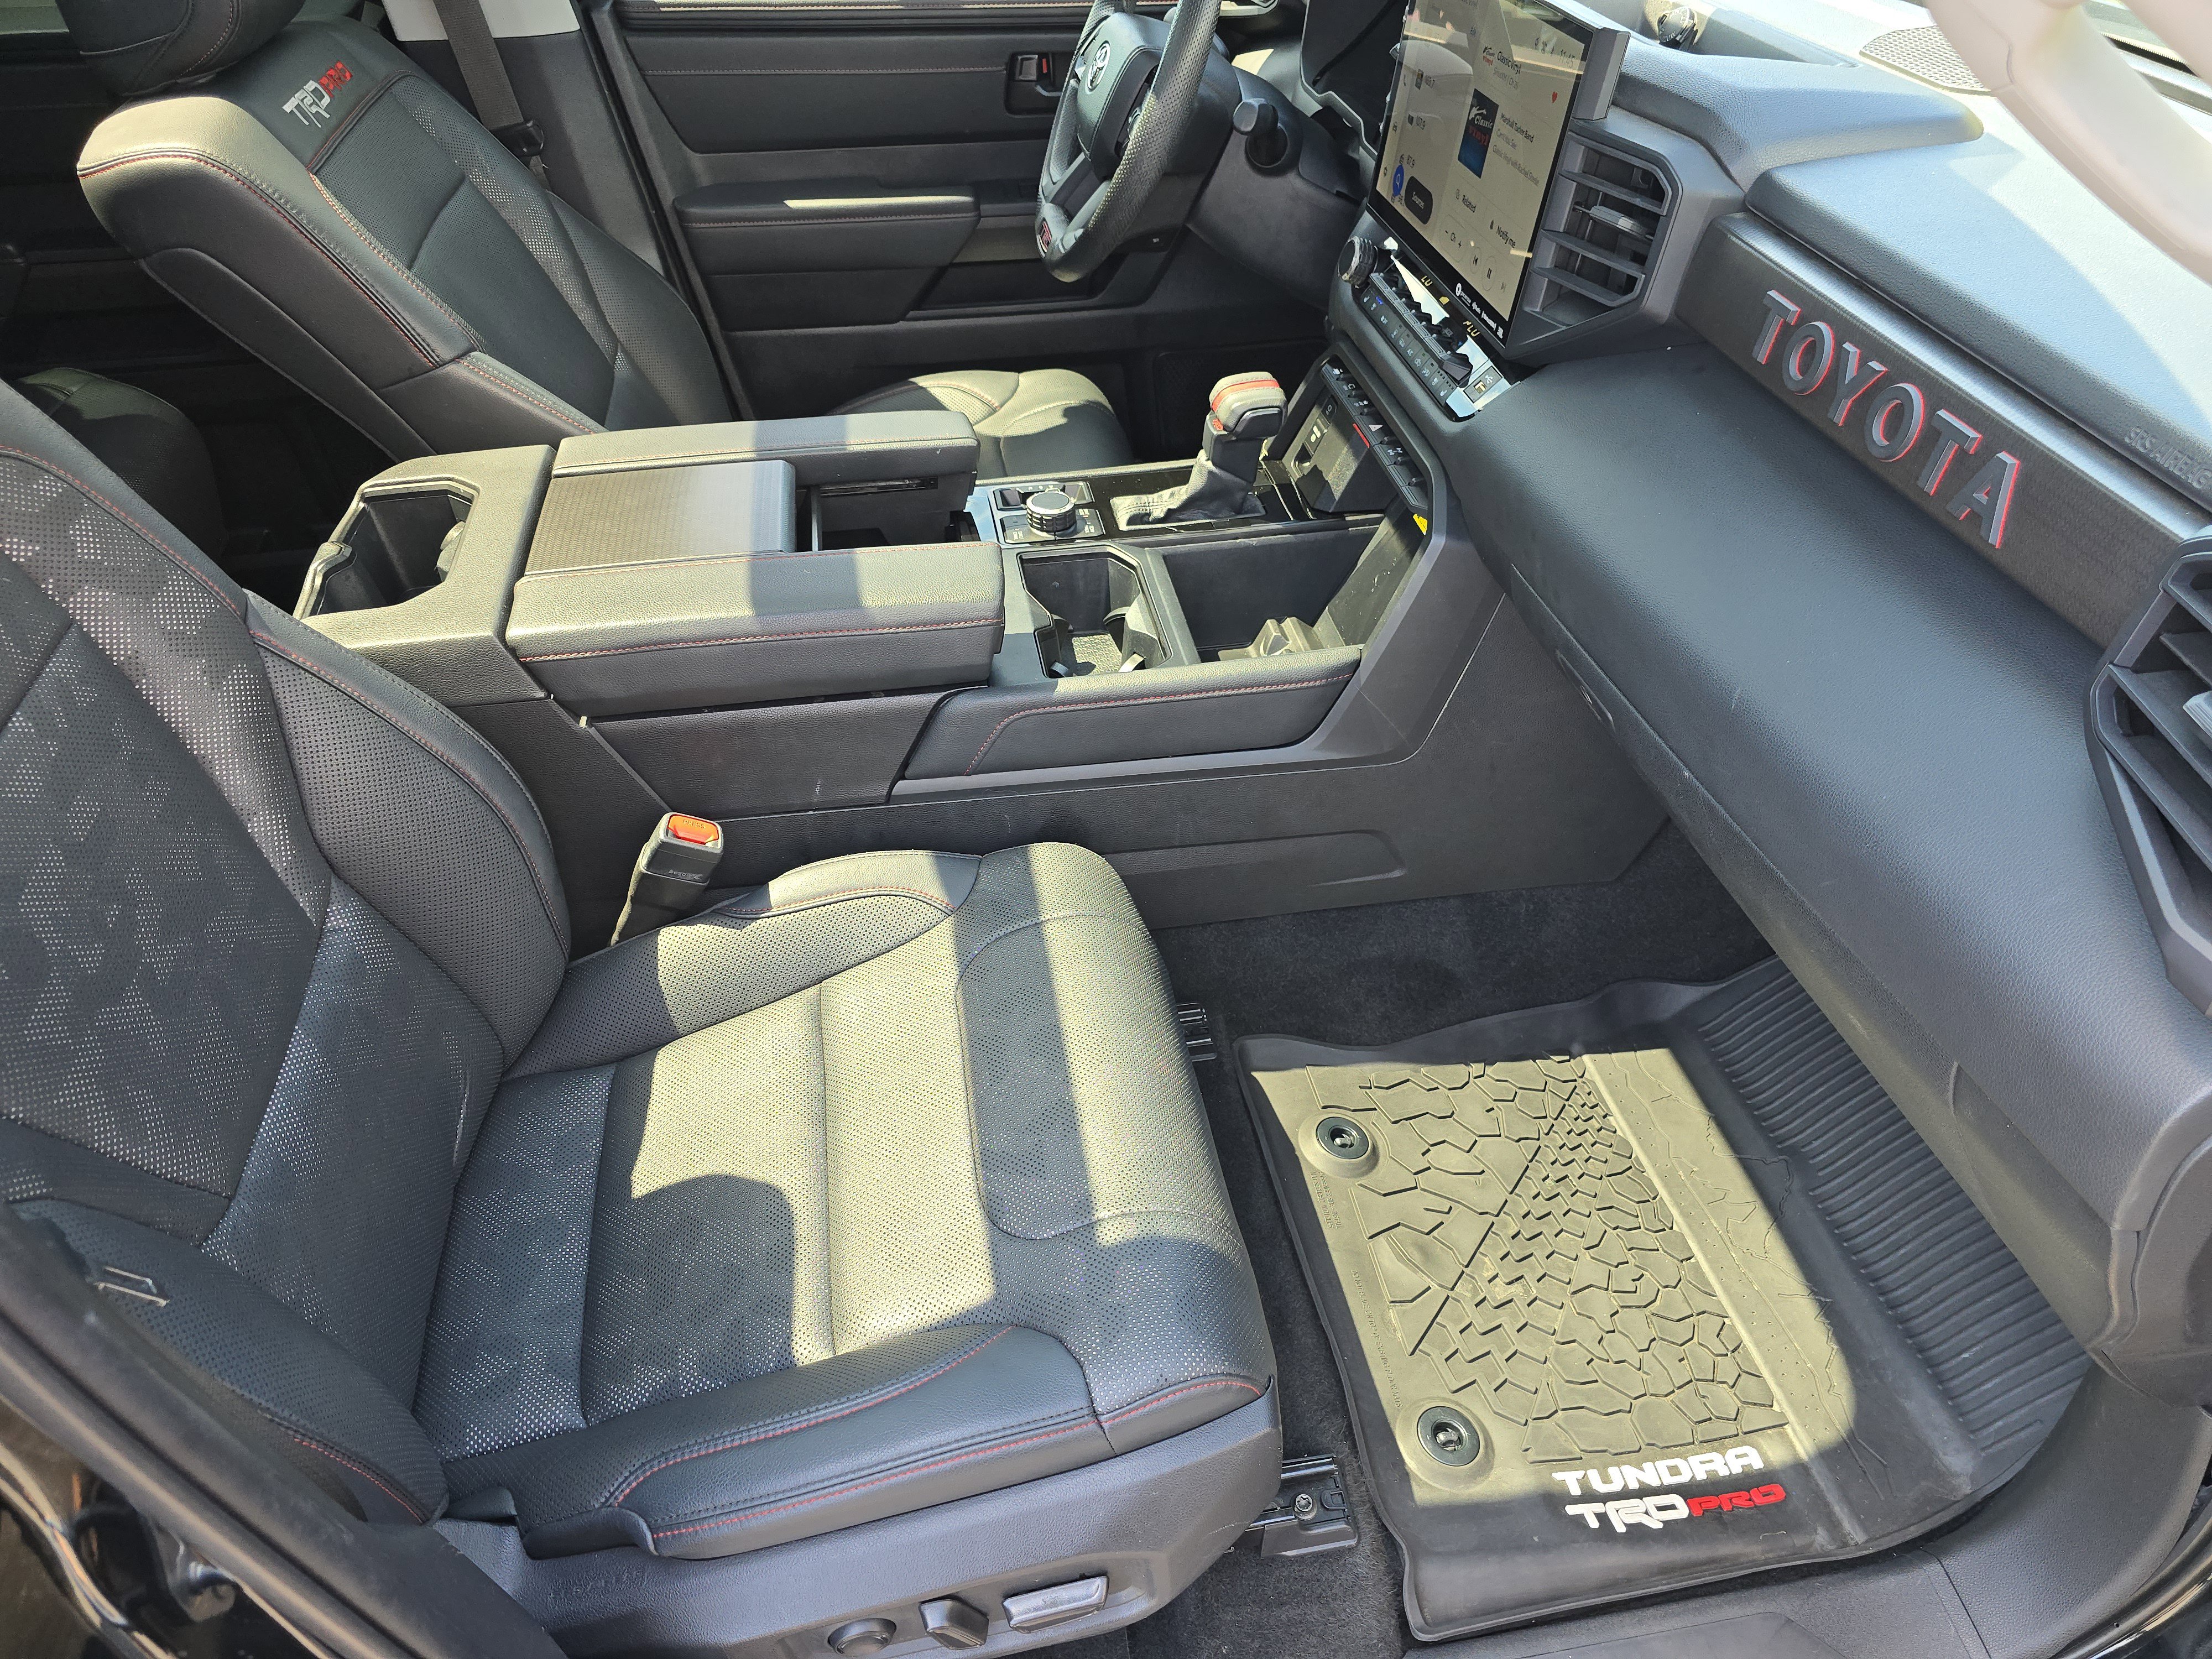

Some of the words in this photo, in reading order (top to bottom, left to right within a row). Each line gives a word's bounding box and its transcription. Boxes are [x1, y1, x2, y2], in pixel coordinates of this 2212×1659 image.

[1497, 51, 1512, 67] Classic
[283, 80, 331, 128] TRD
[319, 60, 353, 98] PRO
[1474, 116, 1493, 129] Classic
[1496, 225, 1509, 244] Notify
[1752, 290, 2021, 549] TOYOTA
[683, 819, 706, 830] PRESS
[1369, 1319, 1378, 1331] TOP
[1385, 1369, 1397, 1390] FLOOR
[1392, 1391, 1403, 1408] MATS
[1552, 1445, 1765, 1496] TUNDRA
[1565, 1494, 1690, 1533] TRD
[1687, 1484, 1786, 1516] PRO
